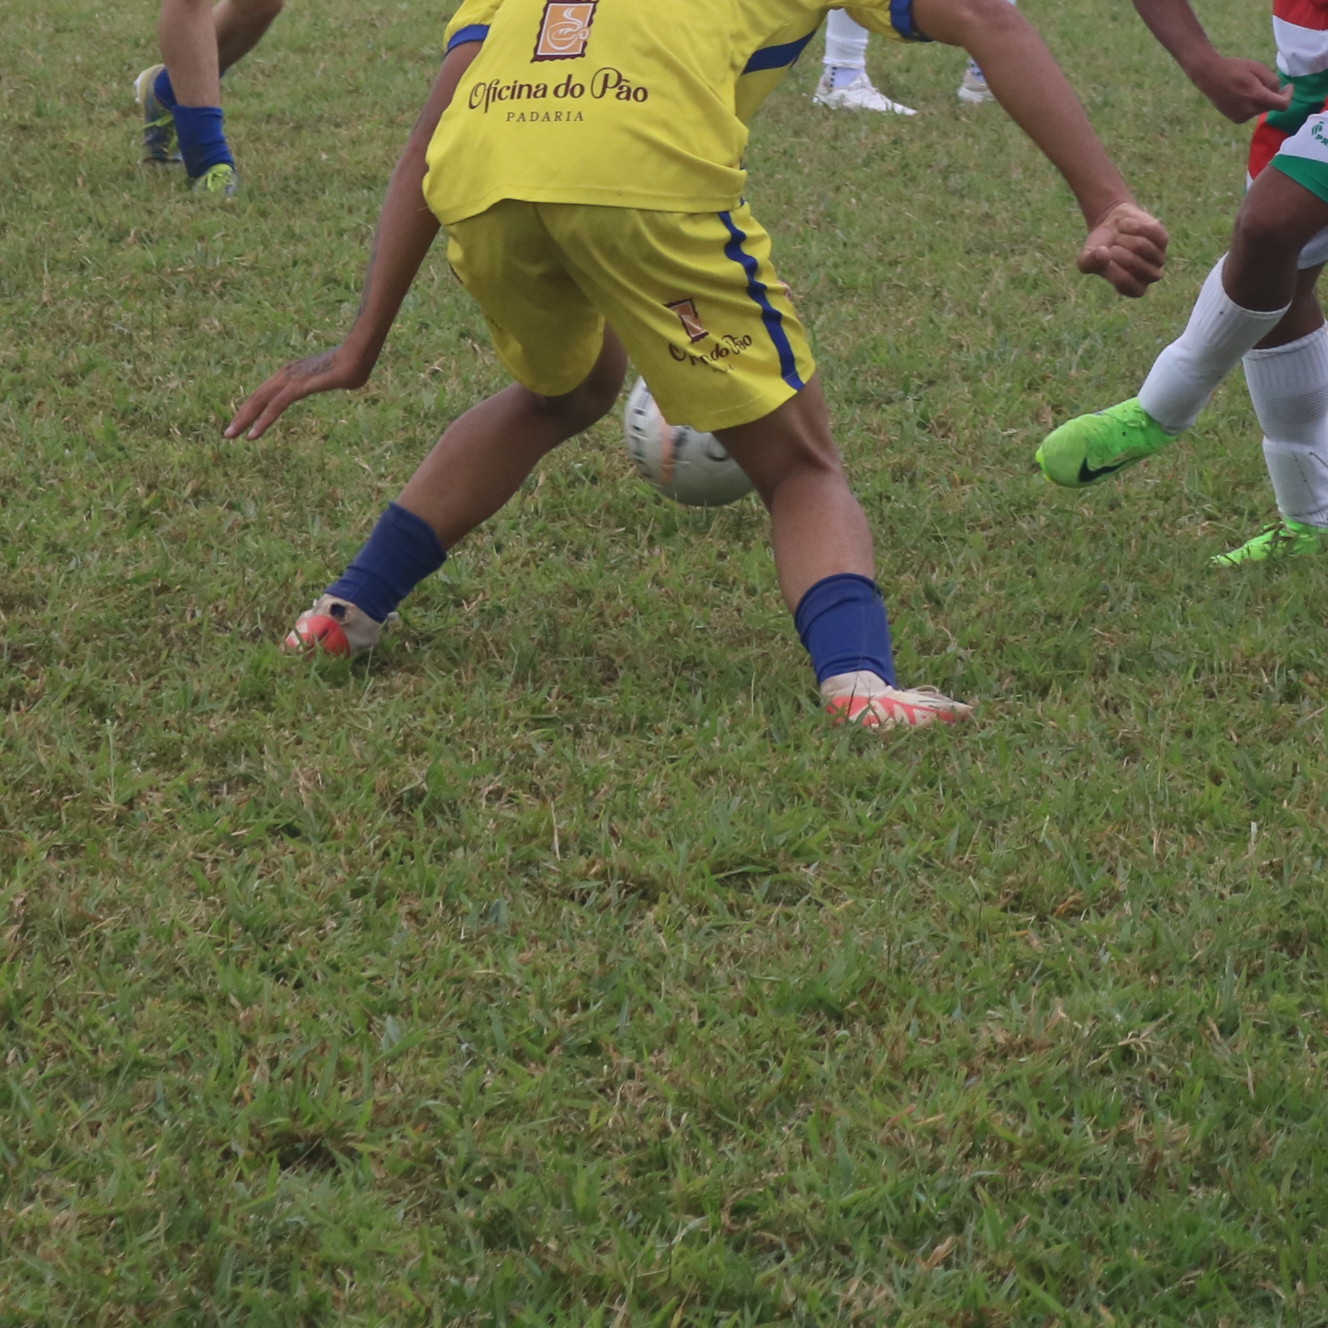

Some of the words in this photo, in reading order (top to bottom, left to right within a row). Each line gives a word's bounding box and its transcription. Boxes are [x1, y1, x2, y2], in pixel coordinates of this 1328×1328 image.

[468, 78, 548, 114] Oficina
[553, 74, 585, 99] do
[590, 67, 649, 103] Pão
[506, 111, 584, 123] PADARIA
